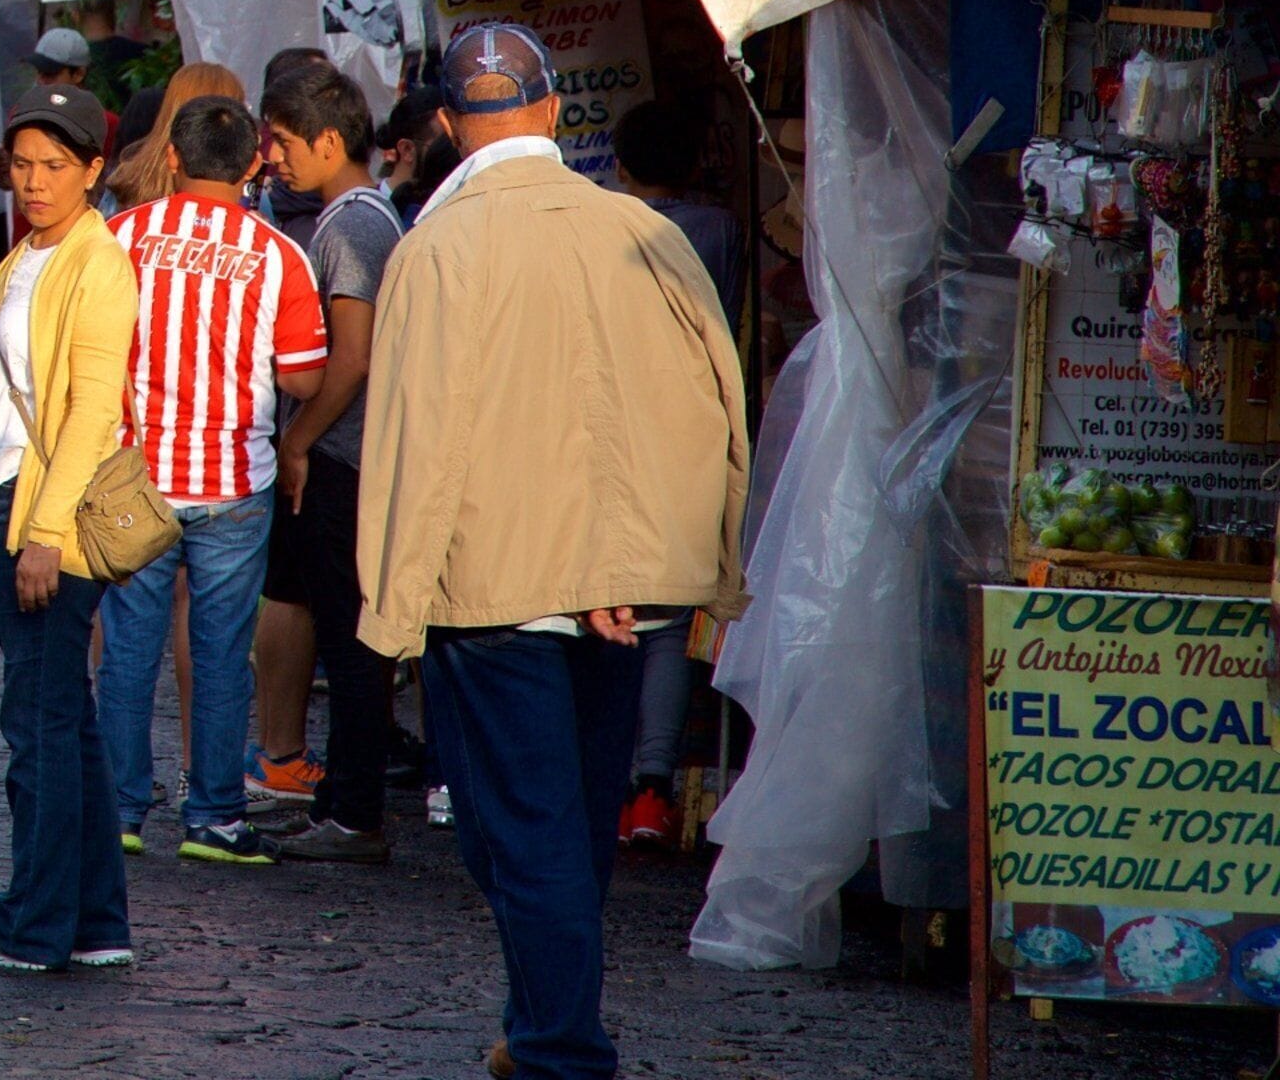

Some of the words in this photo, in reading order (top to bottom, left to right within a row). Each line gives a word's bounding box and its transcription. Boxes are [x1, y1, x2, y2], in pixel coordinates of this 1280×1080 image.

[533, 0, 622, 30] LIMON
[137, 234, 266, 284] TECATE
[1095, 395, 1127, 413] Cel.
[1078, 418, 1110, 437] Tel.
[1114, 420, 1135, 437] 01
[1141, 420, 1188, 442] (739)
[1017, 637, 1161, 683] Antojitos
[1162, 809, 1280, 846] TOSTA
[1244, 863, 1272, 896] Y
